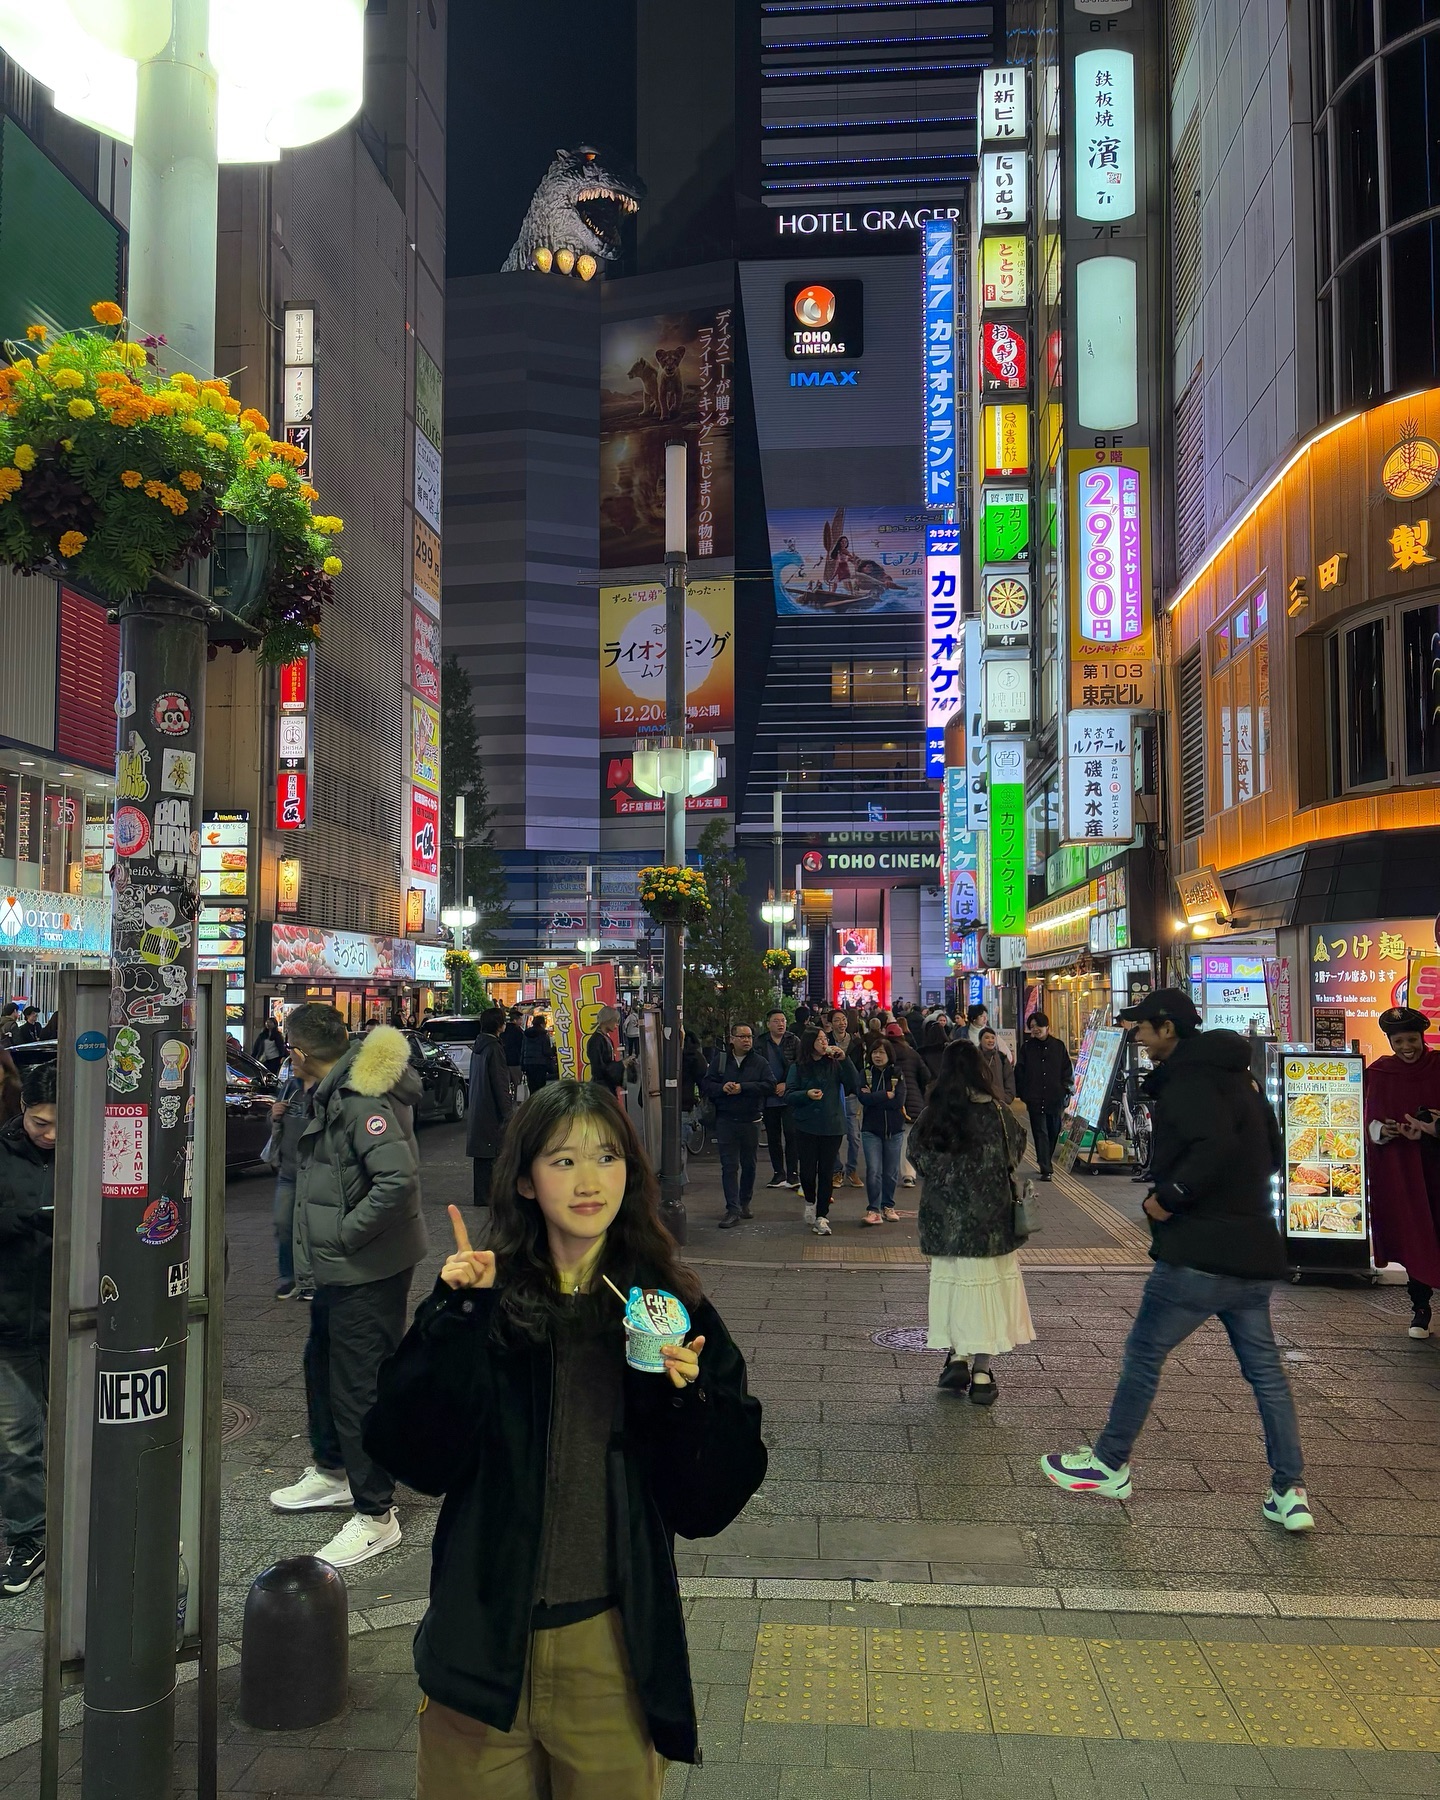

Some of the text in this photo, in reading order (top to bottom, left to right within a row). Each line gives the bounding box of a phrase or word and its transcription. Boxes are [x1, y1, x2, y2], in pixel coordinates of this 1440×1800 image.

[994, 72, 1014, 136] 川新ビル
[1095, 70, 1114, 127] 鉄板焼
[1088, 136, 1122, 169] 濱
[995, 156, 1014, 220] にいむら
[778, 212, 857, 234] HOTEL
[999, 243, 1013, 302] ととりこ
[794, 331, 831, 343] TOHO
[794, 343, 845, 354] CINEMAS
[992, 325, 1018, 378] おすすめ
[716, 308, 731, 427] ディズニーが贈る
[789, 371, 858, 387] IMAX
[989, 380, 1000, 389] 7F
[416, 405, 441, 450] more
[698, 327, 714, 556] 「ライオン・キング」はじまりの物語
[1095, 451, 1122, 463] 9階
[929, 529, 960, 538] カラオケ
[930, 542, 958, 552] 747
[1085, 472, 1120, 638] 2,980円
[1122, 478, 1139, 633] 店舗型ハンドサービス店
[930, 571, 958, 693] カラオケ
[989, 620, 1028, 630] Darts UP
[603, 632, 731, 668] ライオンング
[1001, 636, 1015, 645] 4F
[1083, 664, 1143, 679] 第103
[930, 697, 958, 711] 747
[1083, 683, 1143, 706] 東京ビル
[1003, 721, 1016, 731] 3F
[1073, 740, 1126, 754] ルノアール
[286, 759, 298, 767] 3F
[1084, 759, 1103, 837] 磯丸水産
[155, 800, 190, 827] BOA
[828, 854, 875, 869] TOHO
[1000, 812, 1016, 929] カワノ・クォーク
[956, 880, 974, 915] たば
[26, 910, 83, 931] OKURA
[1209, 960, 1229, 974] 9階
[1315, 969, 1397, 983] 2階テーブル席あります
[1290, 1063, 1301, 1073] 4F
[1306, 1061, 1348, 1075] ふくとら
[134, 1119, 143, 1181] DREAMS
[100, 1369, 166, 1419] NERO
